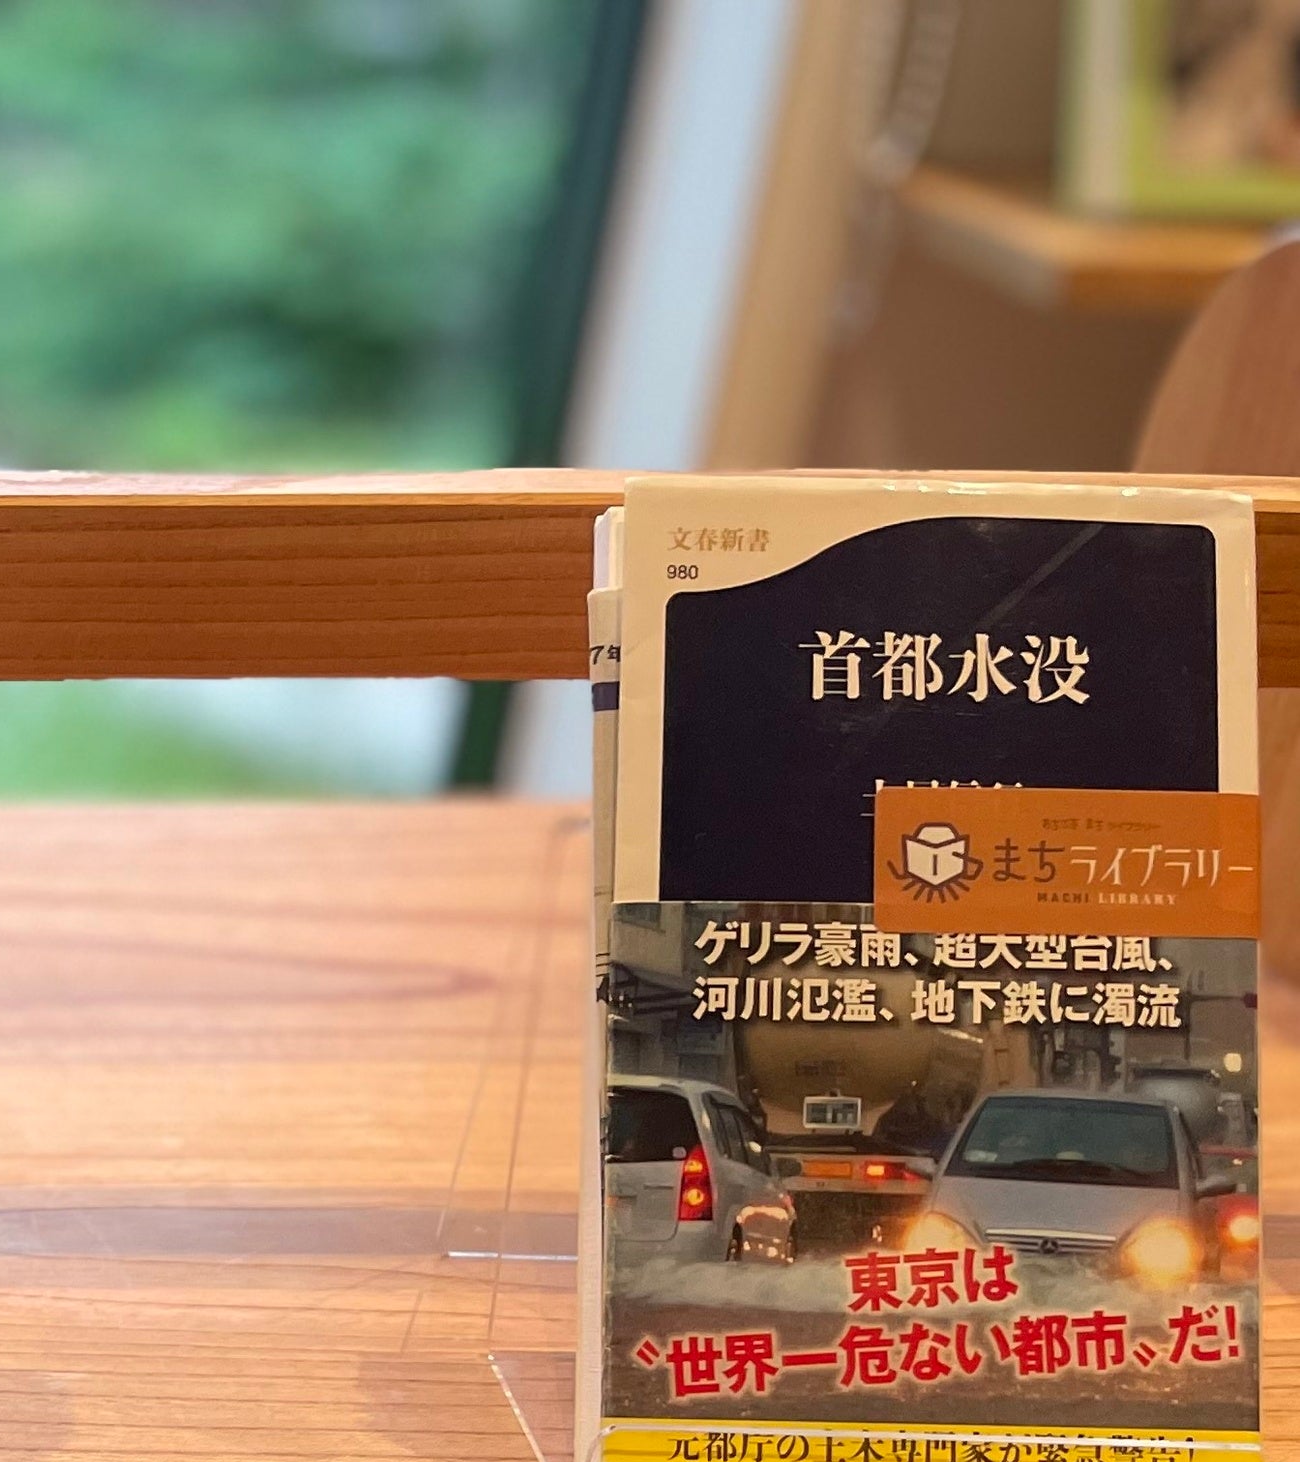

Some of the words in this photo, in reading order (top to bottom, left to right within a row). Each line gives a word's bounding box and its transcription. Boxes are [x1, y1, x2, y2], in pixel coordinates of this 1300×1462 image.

[667, 527, 770, 554] 文春新書
[666, 564, 700, 581] 980
[798, 630, 1091, 705] 首都水没
[992, 837, 1254, 888] まちライブラリー
[1037, 892, 1089, 904] MACHI
[1098, 893, 1177, 905] LIBRARY
[695, 920, 1173, 971] ゲリラ豪雨、超大型台風、
[692, 976, 1181, 1029] 河川氾濫、地下鉄に濁流
[846, 1246, 1020, 1313] 東京は
